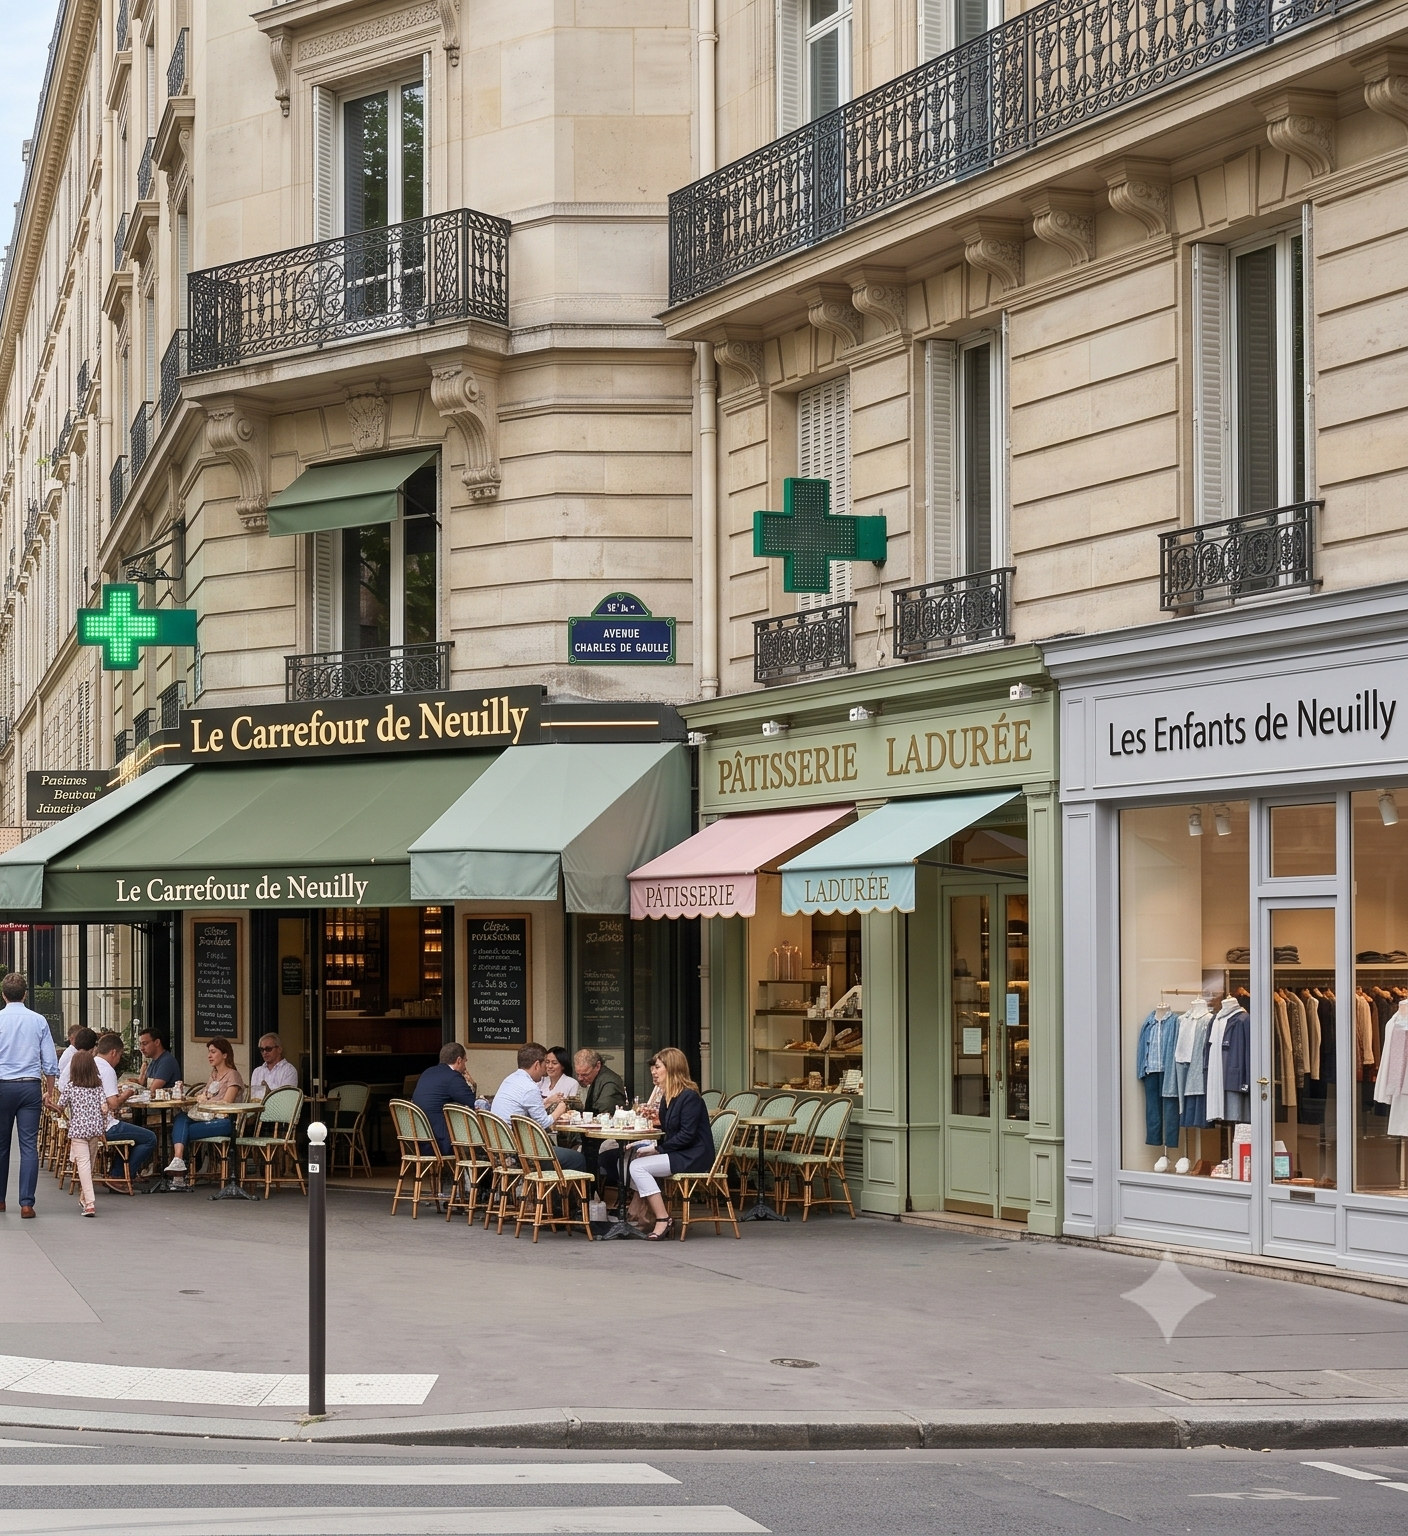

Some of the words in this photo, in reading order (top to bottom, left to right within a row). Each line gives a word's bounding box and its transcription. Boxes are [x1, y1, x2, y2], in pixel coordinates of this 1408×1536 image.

[574, 643, 616, 653] CHARLES
[620, 643, 632, 653] DE
[635, 643, 669, 653] GAULLE
[603, 628, 640, 638] AVENUE
[190, 719, 224, 753] Le
[230, 709, 370, 751] Carrefour
[376, 703, 411, 742] de
[418, 695, 530, 745] Neuilly
[1109, 722, 1146, 756] Les
[1154, 711, 1246, 752] Enfants
[1254, 702, 1288, 742] de
[1297, 689, 1397, 741] Neuilly
[718, 743, 858, 795] PÂTISSERIE
[886, 712, 1032, 776] LADURÉE
[116, 879, 141, 902] Le
[146, 876, 250, 902] Carrefour
[255, 875, 282, 900] de
[286, 872, 369, 905] Neuilly
[804, 871, 890, 903] LADURÉE
